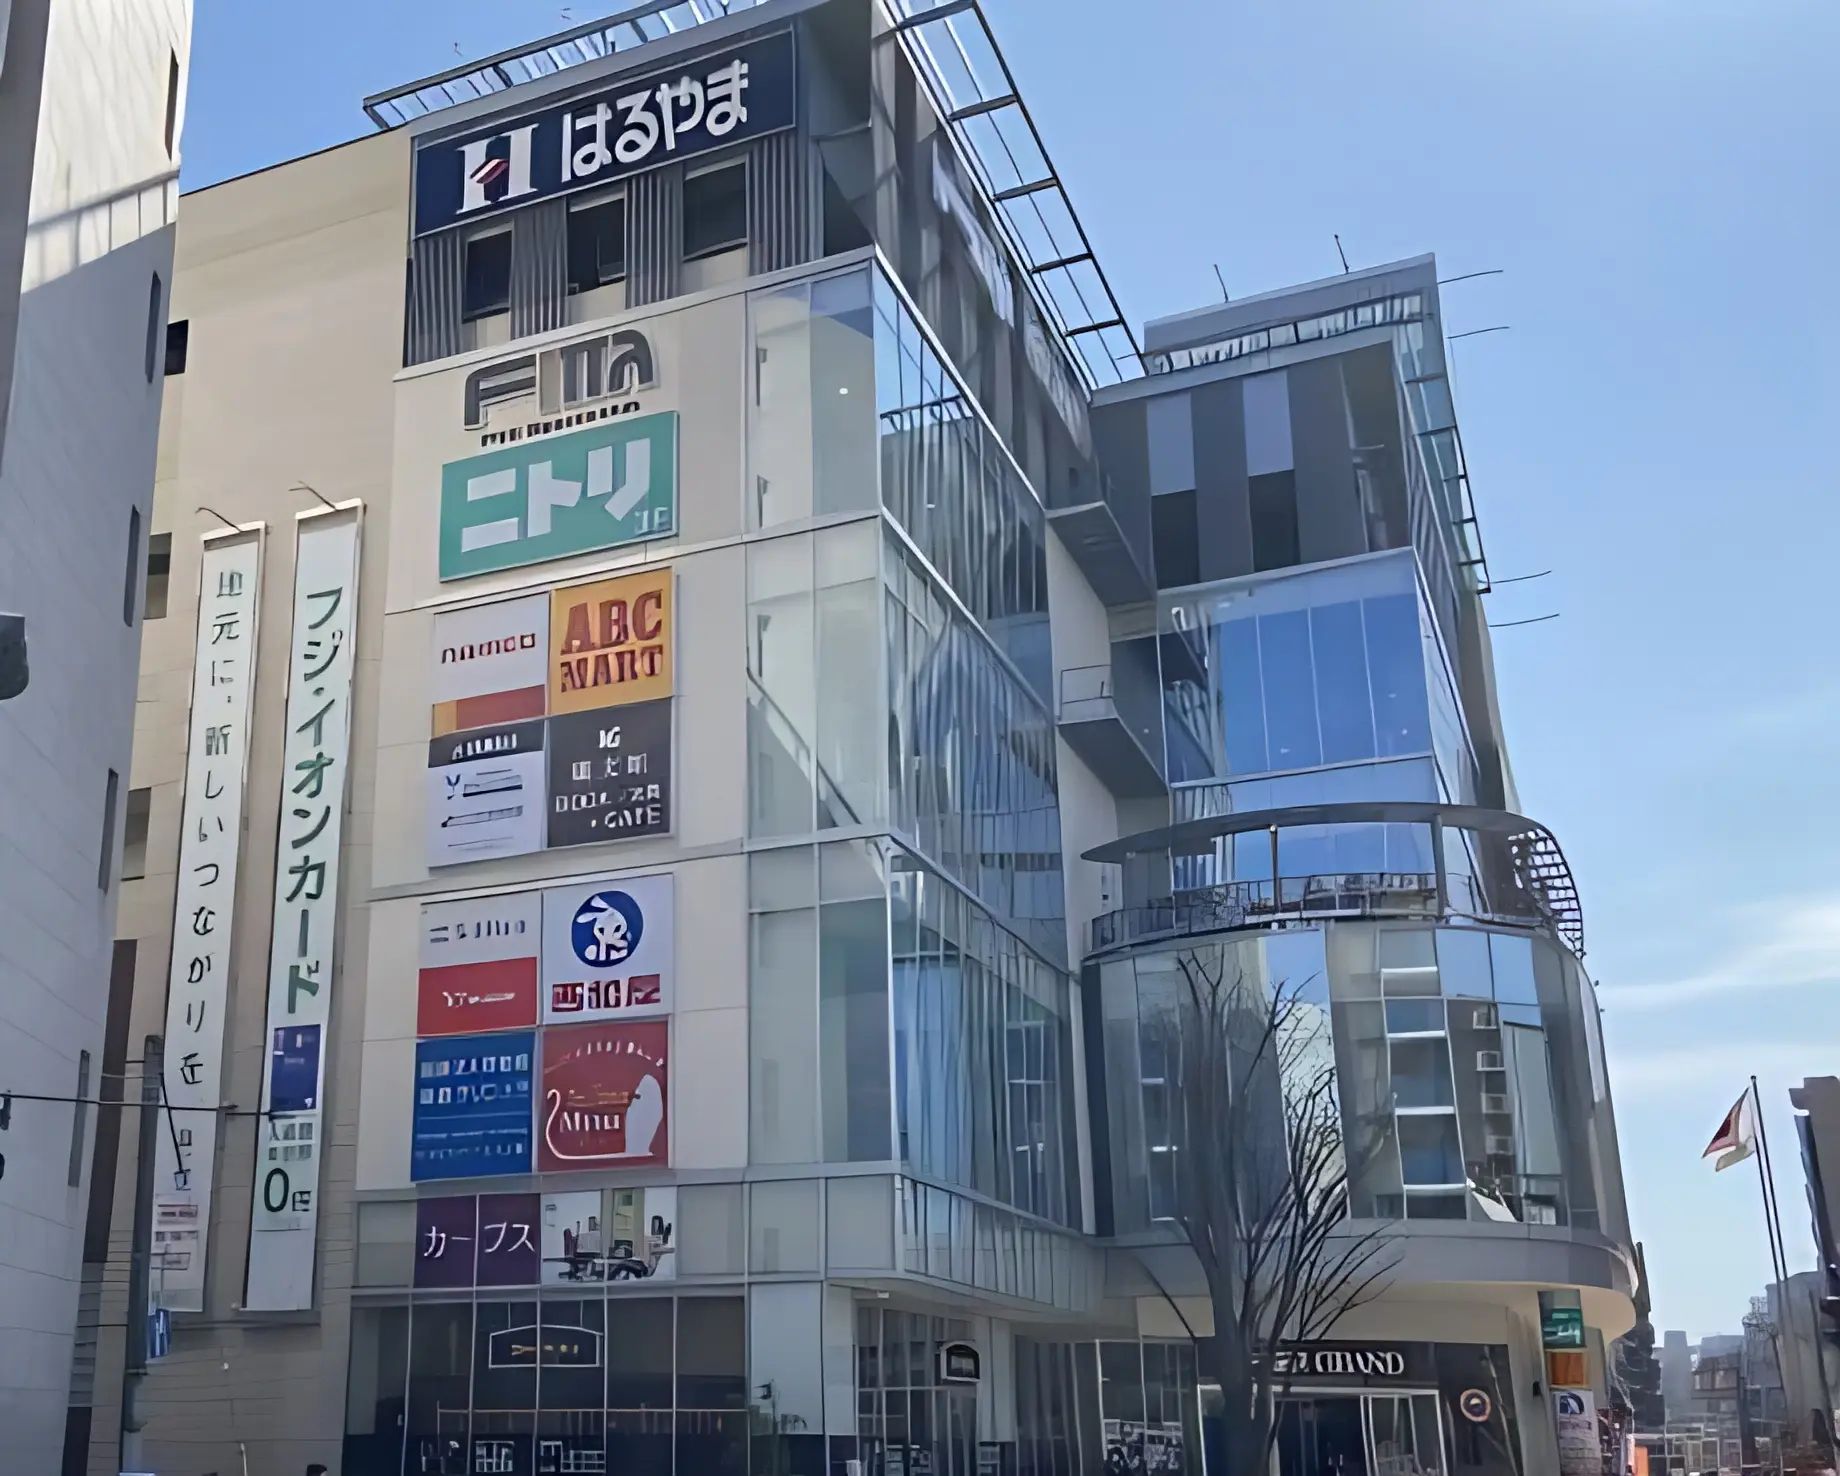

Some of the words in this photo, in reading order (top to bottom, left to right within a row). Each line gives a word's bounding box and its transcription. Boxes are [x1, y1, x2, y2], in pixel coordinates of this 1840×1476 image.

[561, 59, 749, 183] はるやま
[461, 438, 651, 553] ニトリ
[560, 588, 664, 656] ABC
